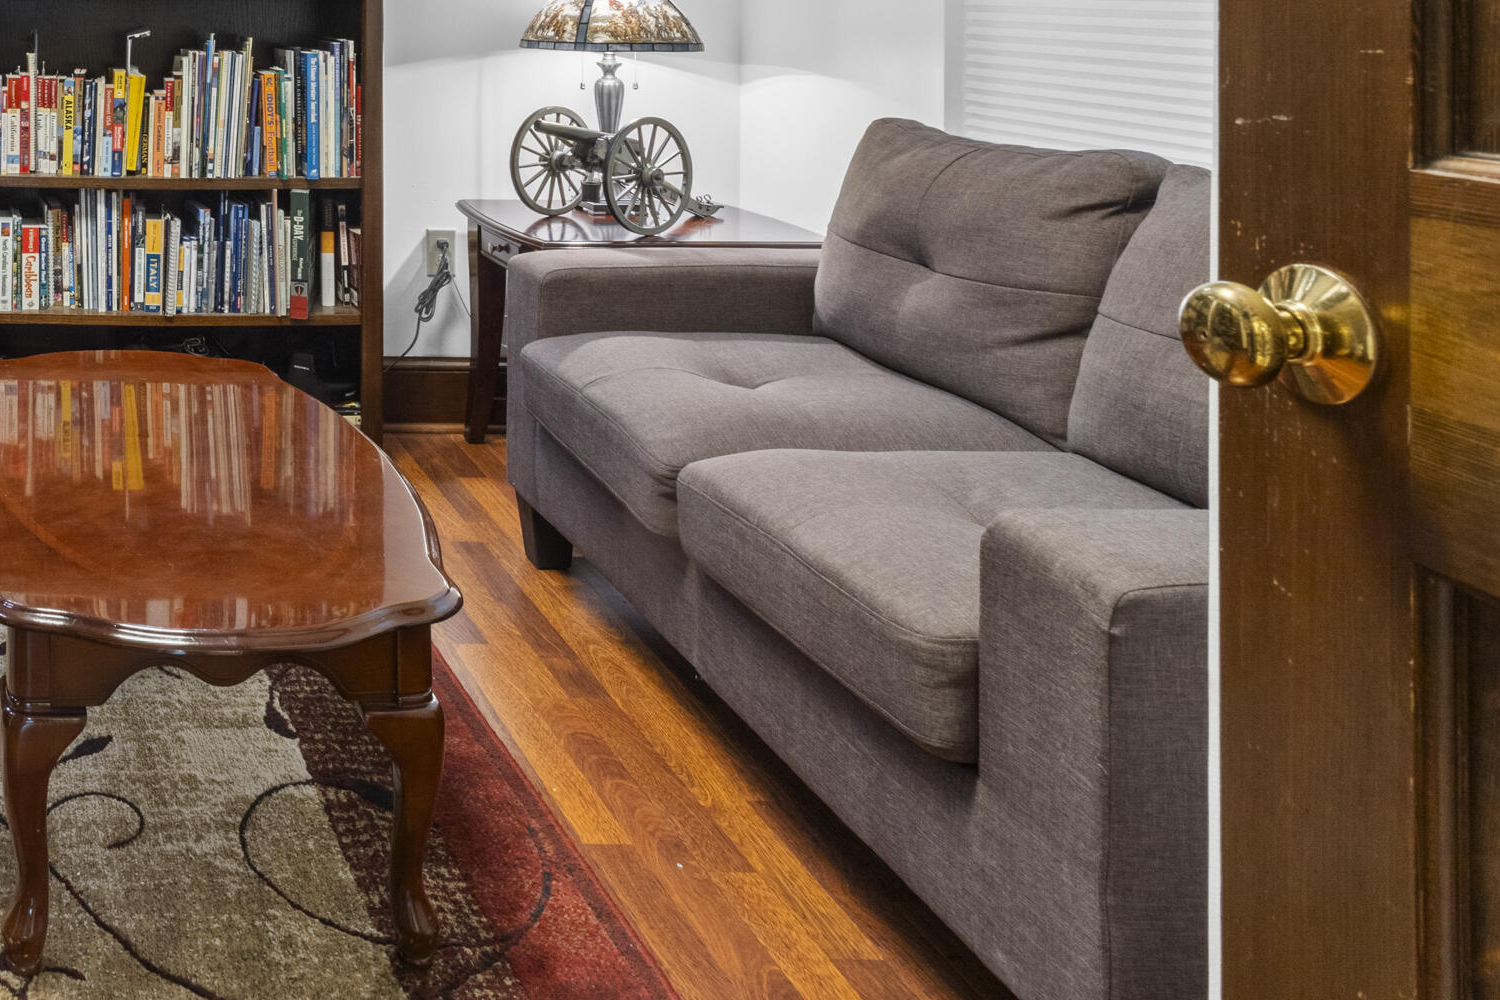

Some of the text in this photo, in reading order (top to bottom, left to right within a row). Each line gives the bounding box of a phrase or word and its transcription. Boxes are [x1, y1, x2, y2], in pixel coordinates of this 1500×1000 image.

[142, 134, 151, 163] GERMAN
[266, 94, 275, 167] IDIOT'S Football
[24, 256, 37, 299] Caribbean
[149, 258, 157, 288] ITALY
